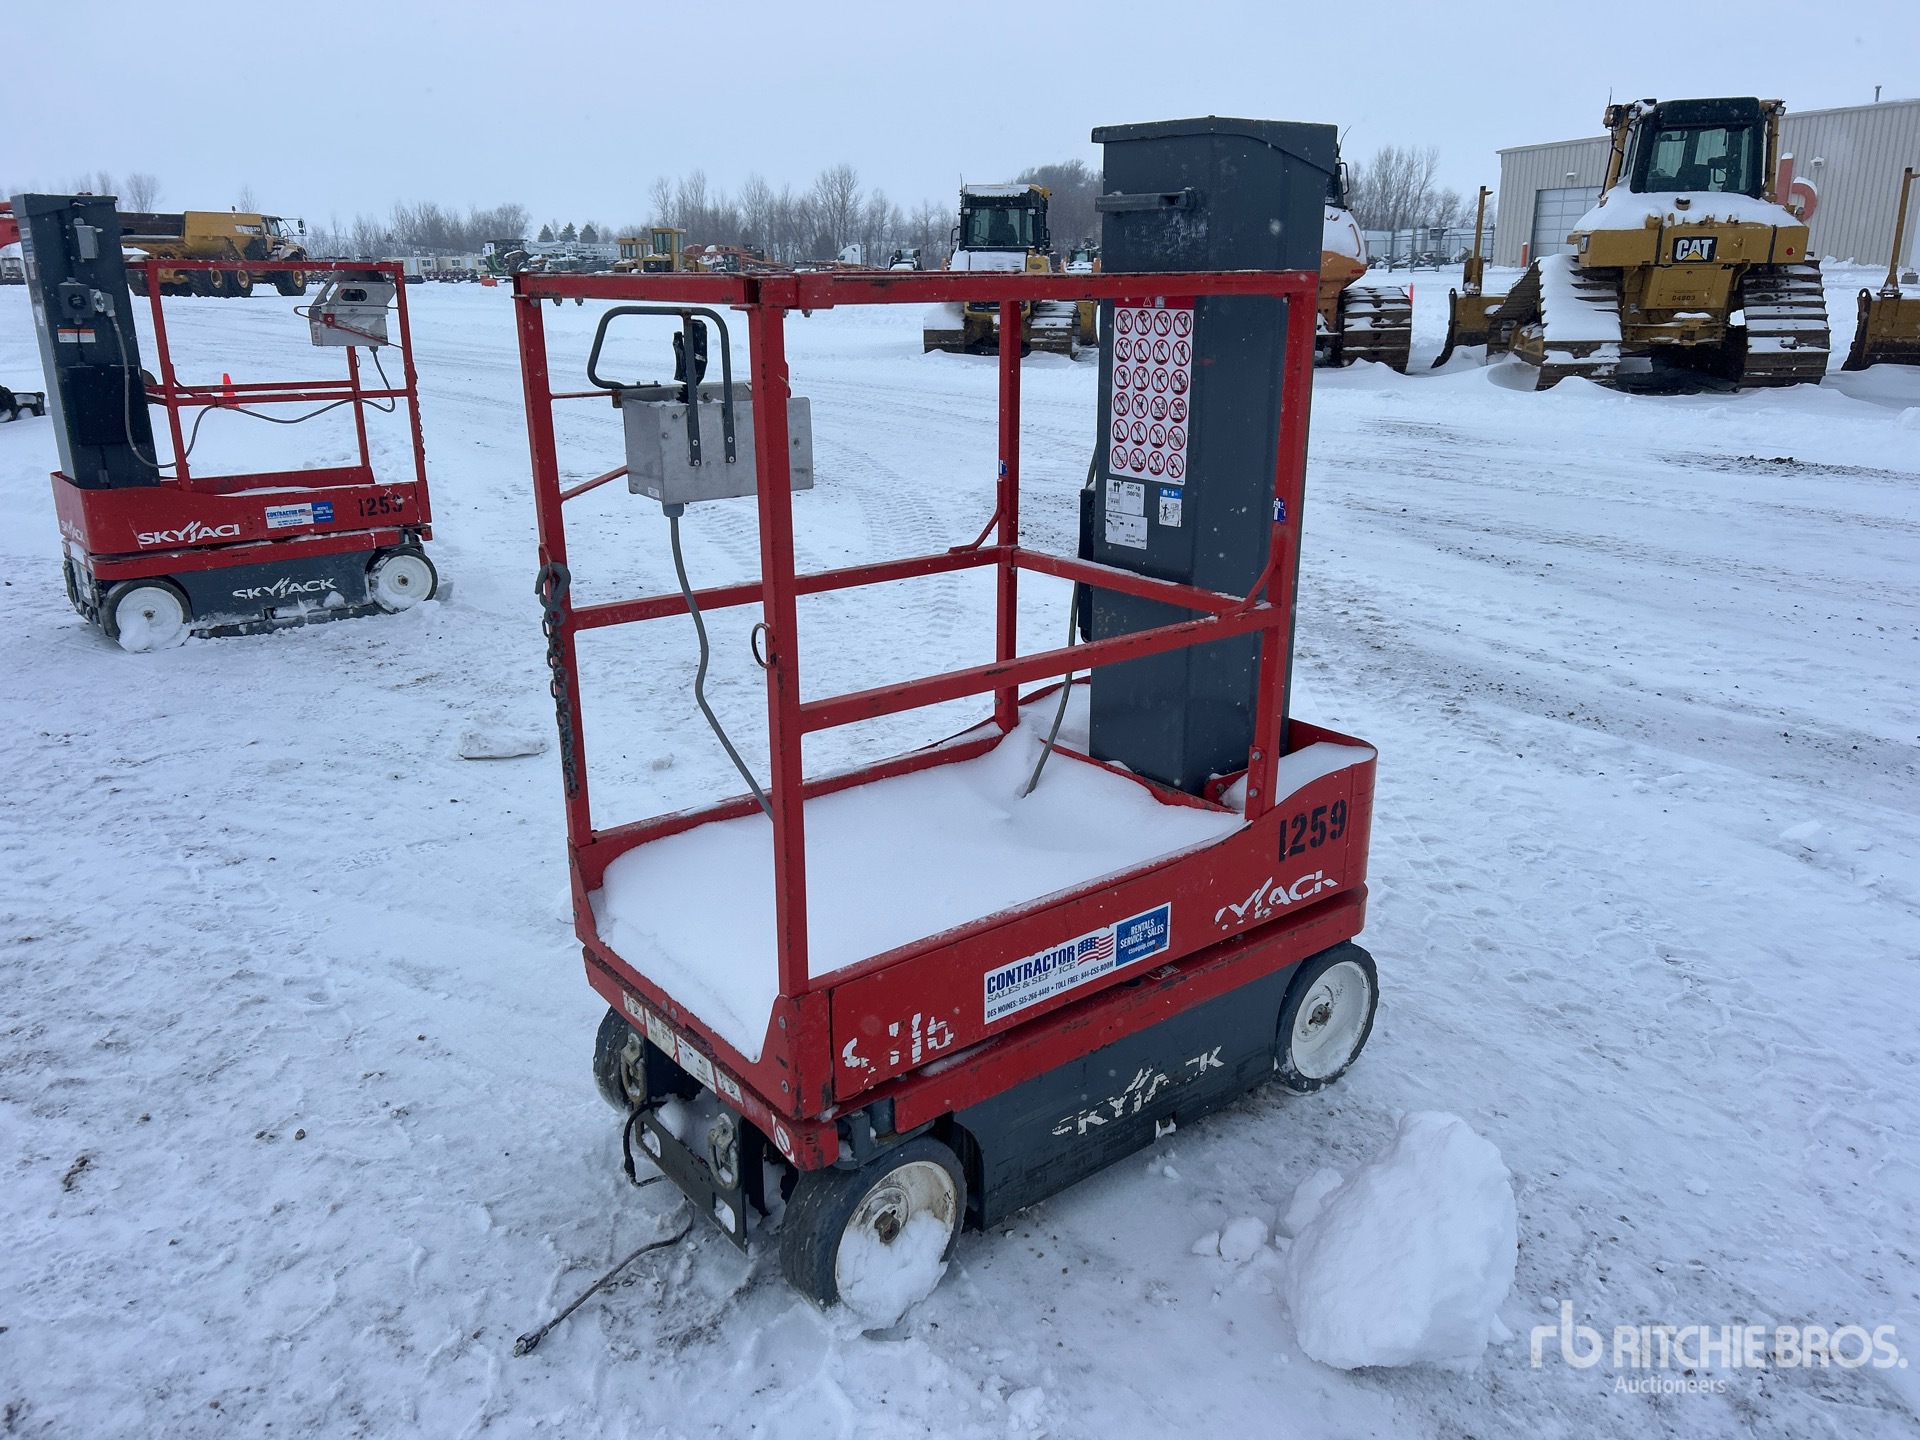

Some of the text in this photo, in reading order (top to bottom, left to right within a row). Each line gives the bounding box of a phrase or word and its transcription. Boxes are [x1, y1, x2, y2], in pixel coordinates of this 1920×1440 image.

[1676, 239, 1713, 260] CAT
[232, 577, 337, 599] SKYJACK
[1279, 799, 1347, 862] 1259
[1214, 870, 1338, 930] YJACK
[1120, 924, 1165, 949] SERVICE SALES
[1130, 918, 1155, 936] RENTALS
[987, 945, 1076, 995] CONTRACTOR
[987, 962, 1076, 1003] SALES & SERICE
[987, 1008, 997, 1018] DES
[998, 1000, 1017, 1014] MOINES:
[1055, 977, 1067, 990] TOLL
